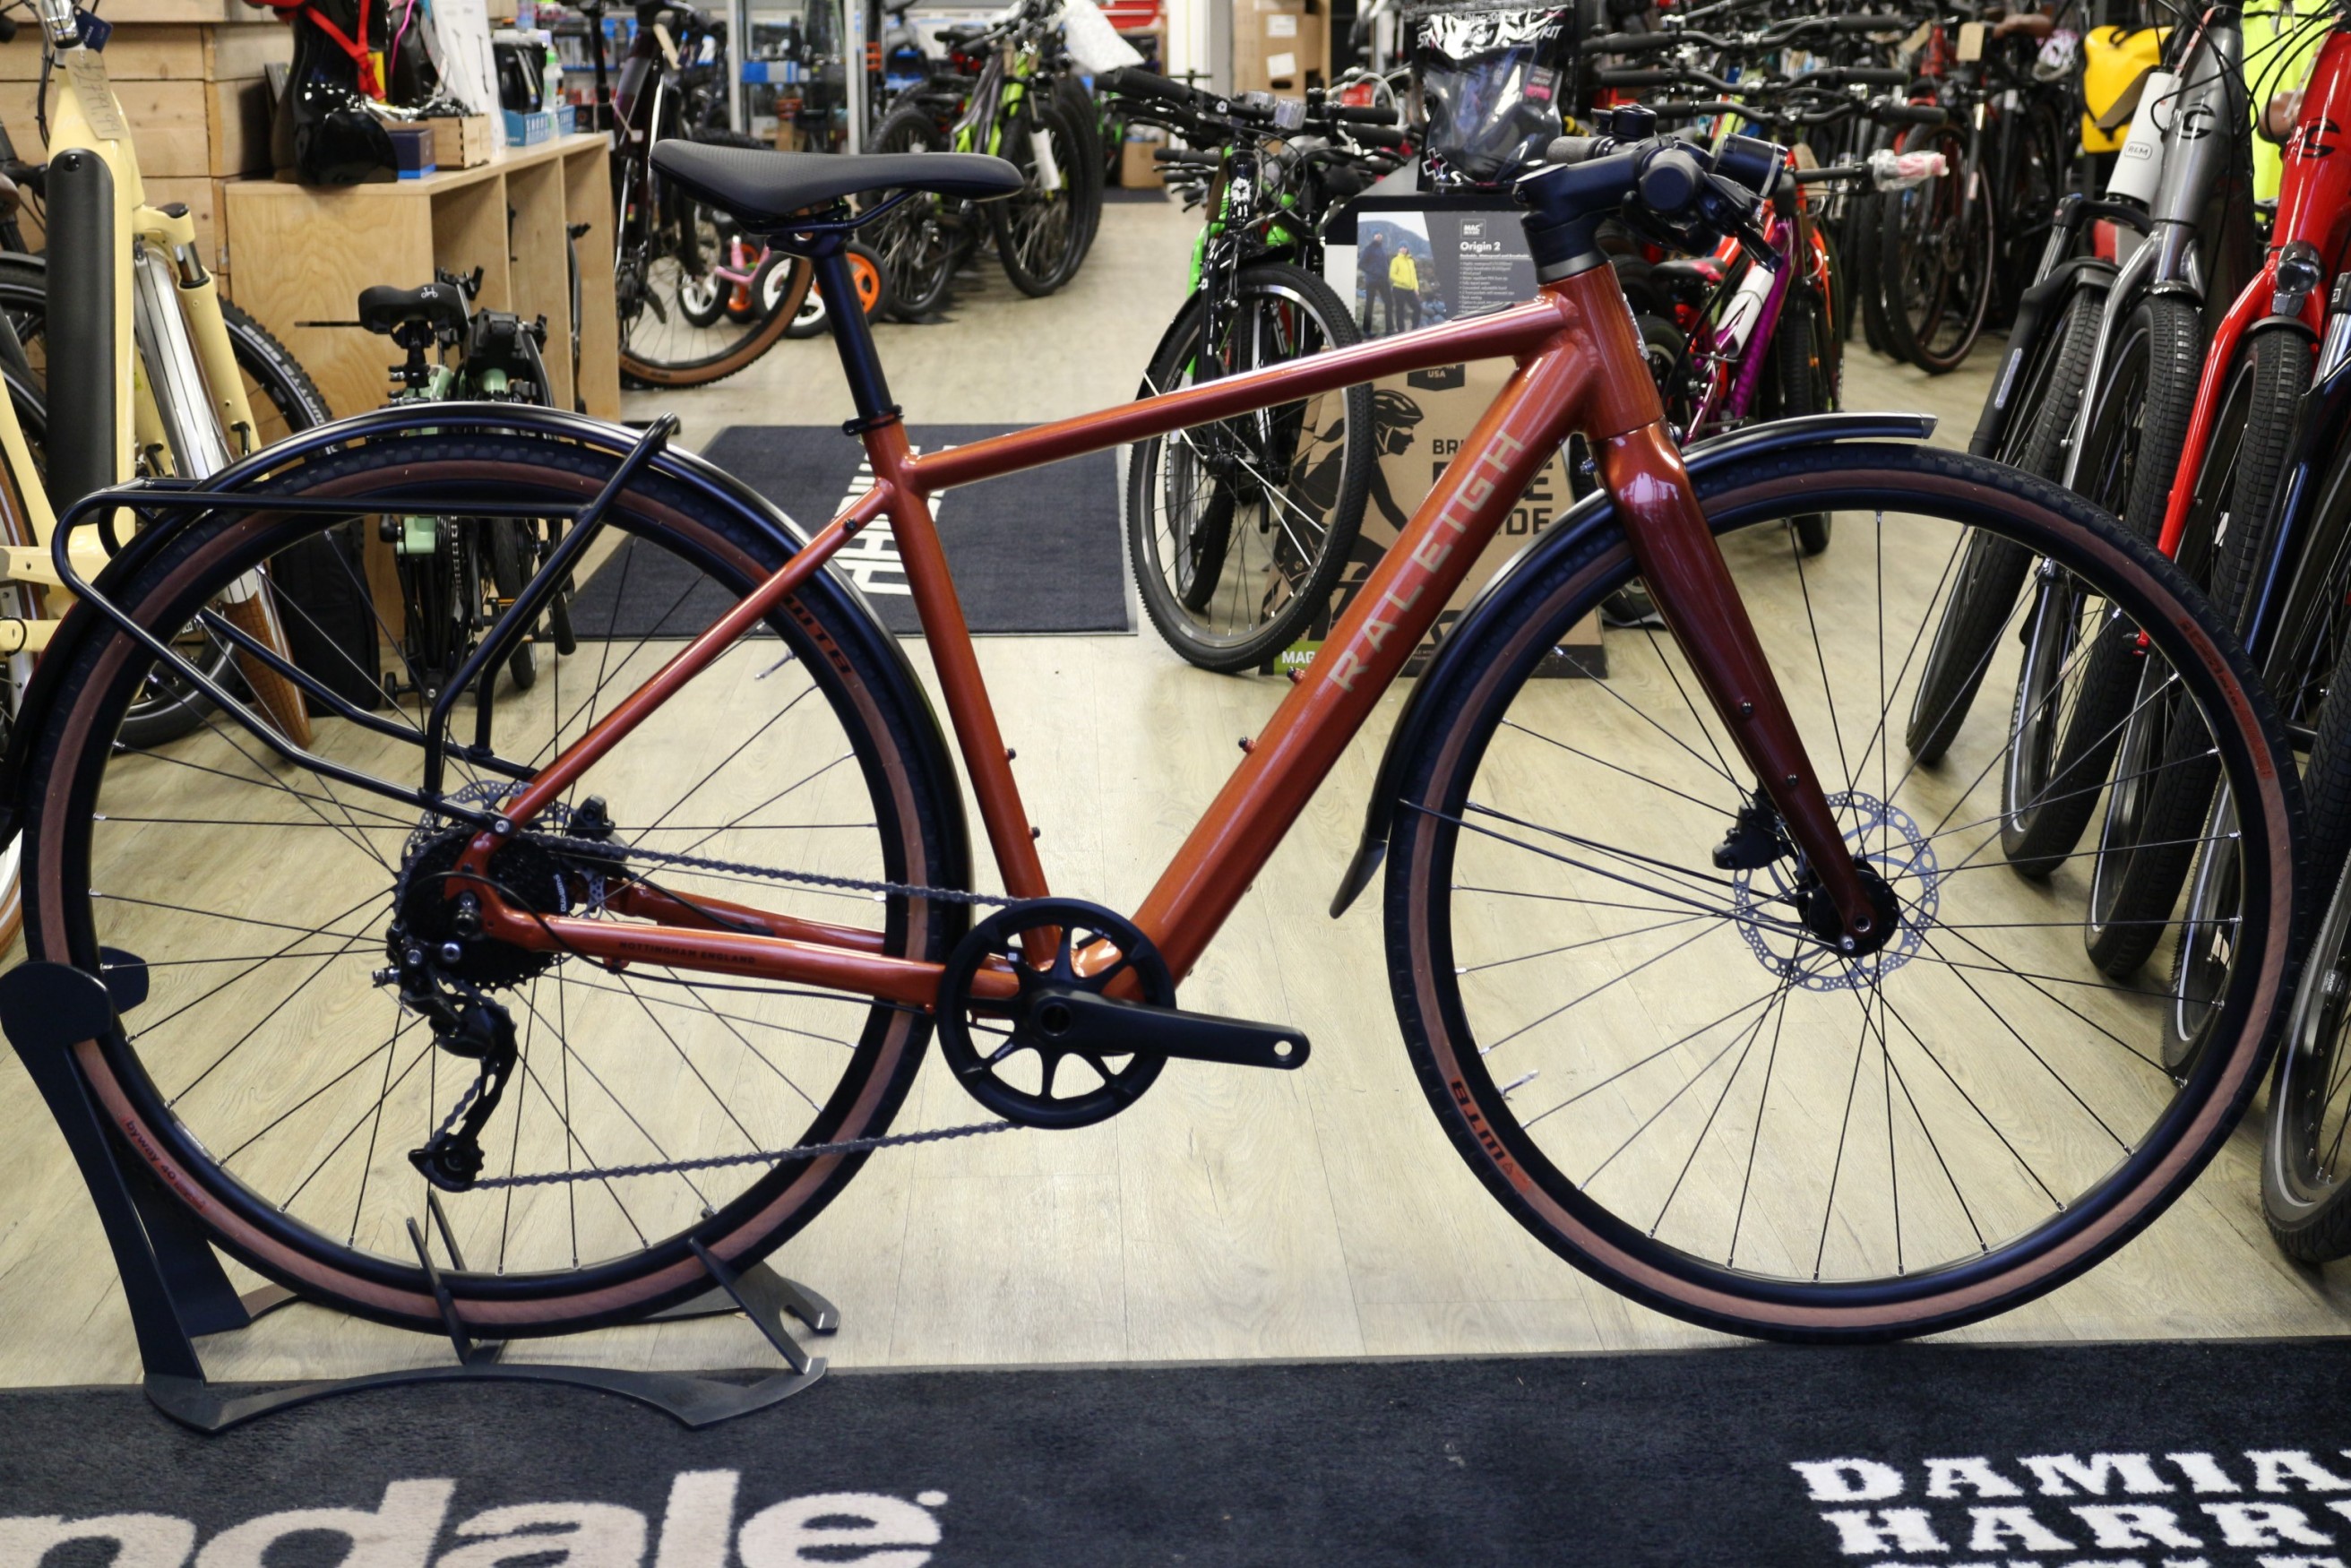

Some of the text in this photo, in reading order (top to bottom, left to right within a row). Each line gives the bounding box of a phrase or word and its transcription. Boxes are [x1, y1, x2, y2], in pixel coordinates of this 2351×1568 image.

[1460, 241, 1501, 253] Origin 2
[1427, 370, 1446, 378] USA
[1328, 430, 1525, 693] RALEIGH
[619, 942, 756, 964] NOTTINGHAM ENGLAND
[125, 1119, 160, 1162] byway
[1451, 1081, 1506, 1161] WTB
[1790, 1448, 2351, 1502] DAMIA
[1820, 1502, 2351, 1555] HARR
